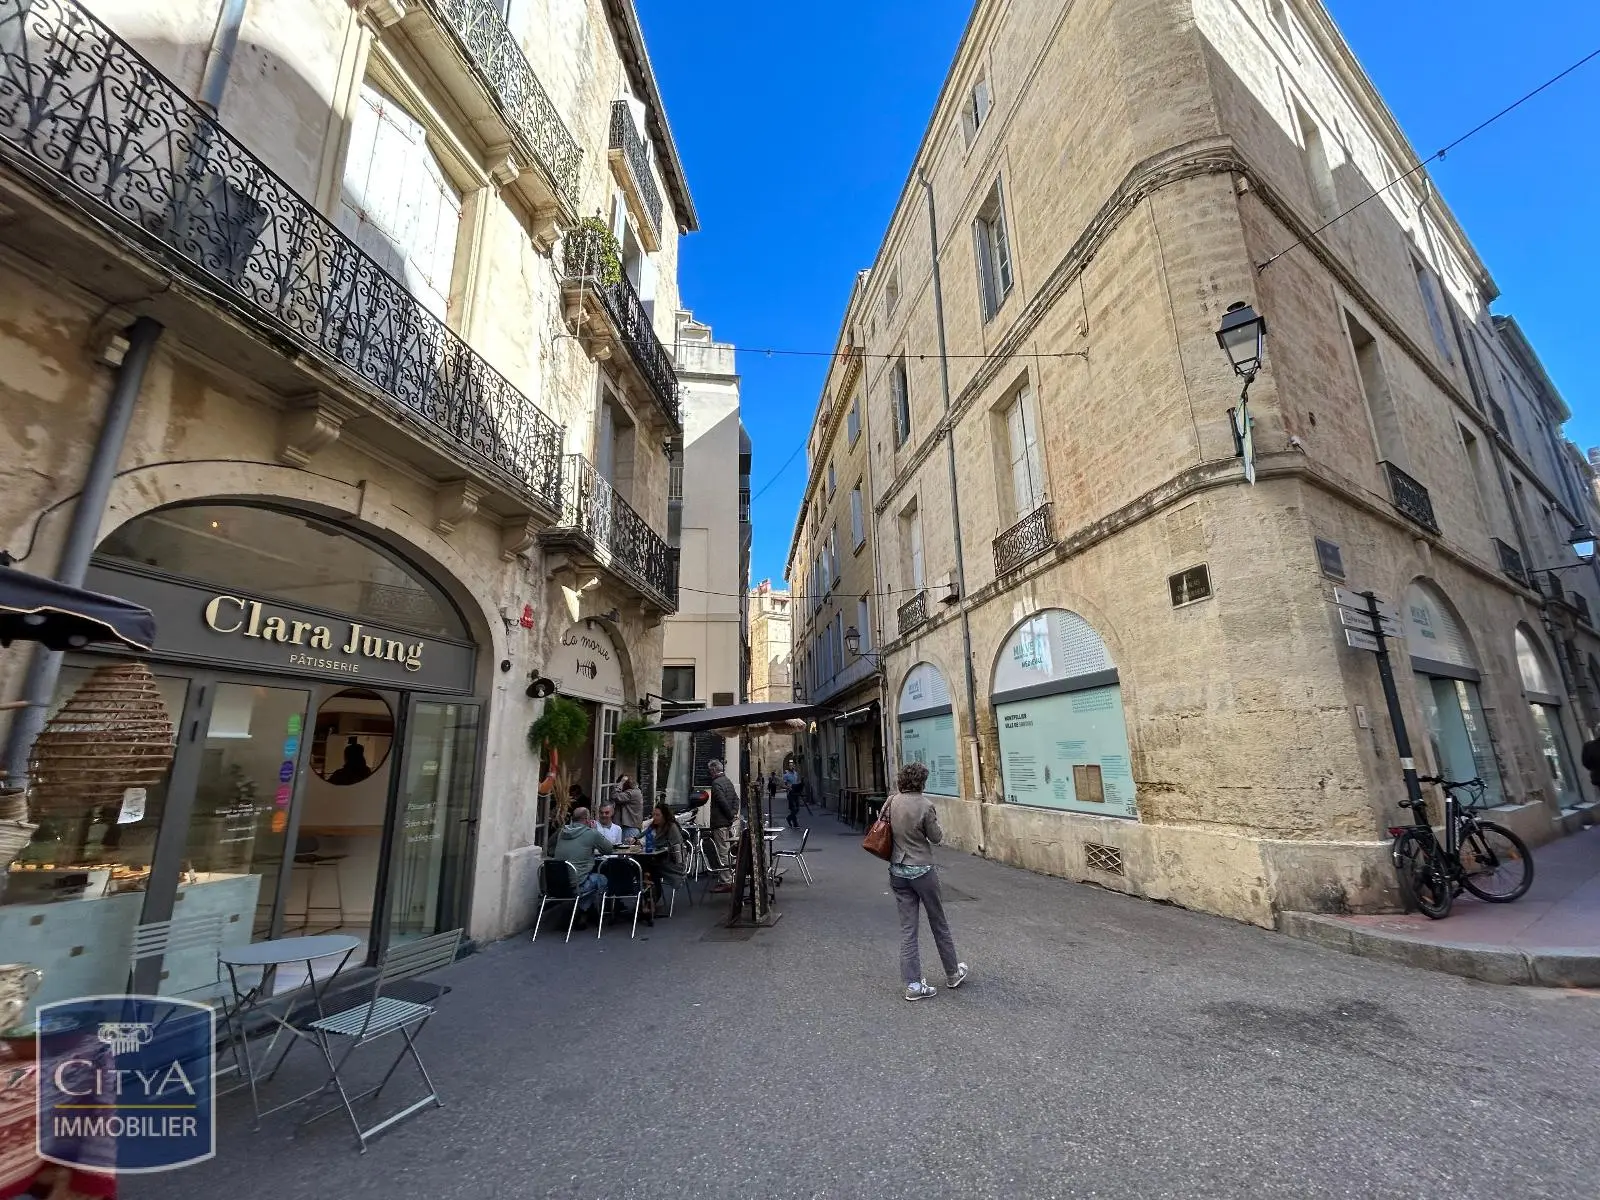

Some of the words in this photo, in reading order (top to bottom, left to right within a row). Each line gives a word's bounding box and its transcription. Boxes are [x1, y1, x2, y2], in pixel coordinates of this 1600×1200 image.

[205, 595, 333, 650] Clara
[343, 622, 425, 672] Jung
[562, 628, 579, 647] La
[581, 636, 611, 661] morue
[289, 653, 360, 673] PÂTISSERIE
